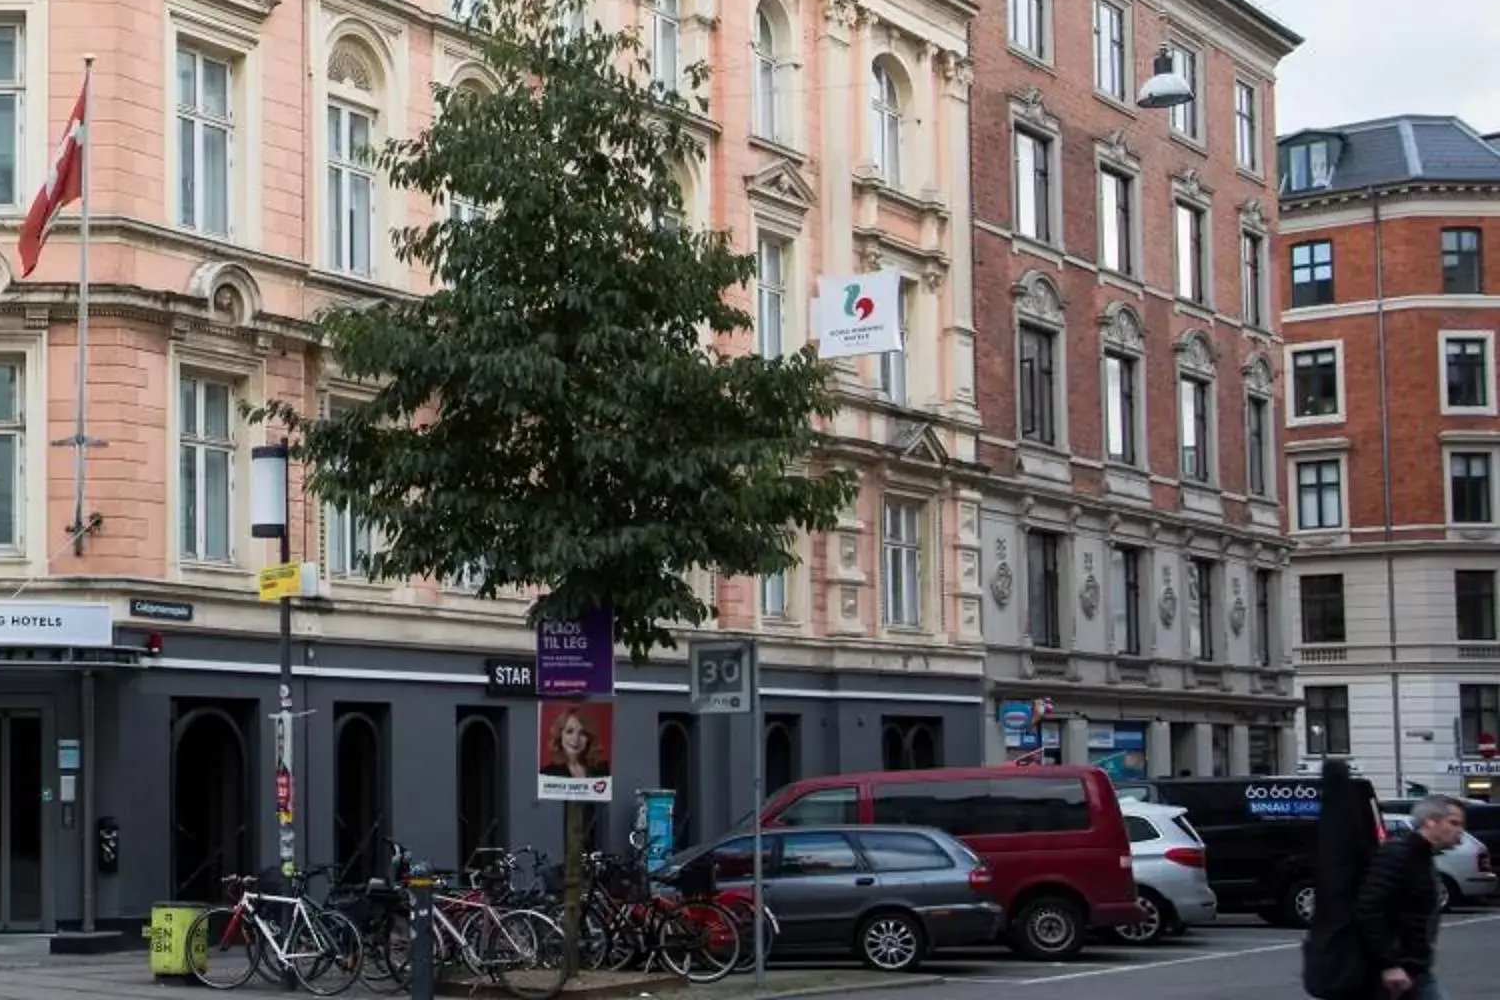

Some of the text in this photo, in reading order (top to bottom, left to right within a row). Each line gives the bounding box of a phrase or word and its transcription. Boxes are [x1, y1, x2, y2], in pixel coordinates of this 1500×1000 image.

[11, 616, 63, 627] HOTELS
[543, 636, 588, 649] TIL LEG
[495, 666, 532, 685] STAR
[702, 660, 740, 683] 30
[1245, 784, 1317, 799] 60 60 60
